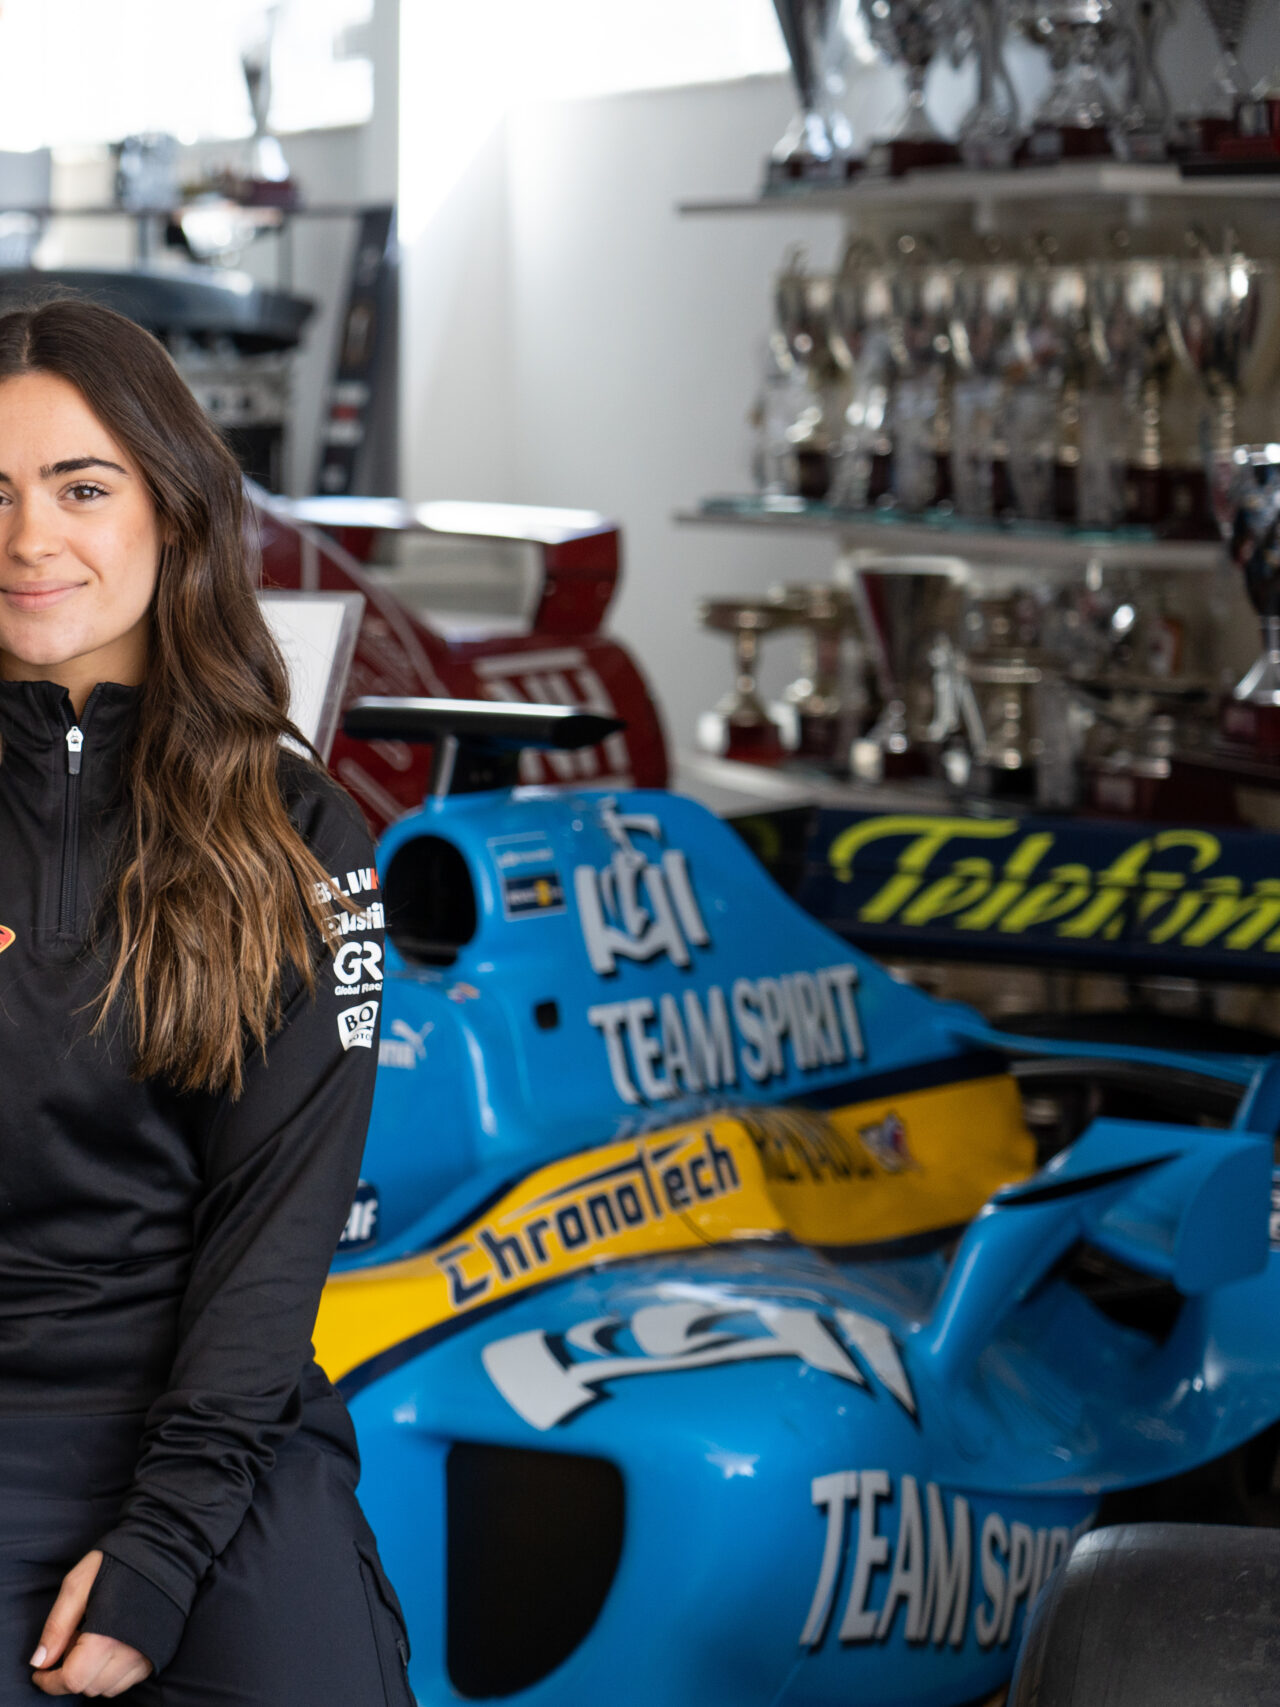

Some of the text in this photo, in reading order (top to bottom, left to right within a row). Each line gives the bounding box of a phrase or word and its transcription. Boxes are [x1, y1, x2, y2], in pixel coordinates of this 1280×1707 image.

[334, 984, 360, 996] Global
[587, 963, 865, 1105] TEAM SPIRIT
[798, 1470, 969, 1647] TEAM
